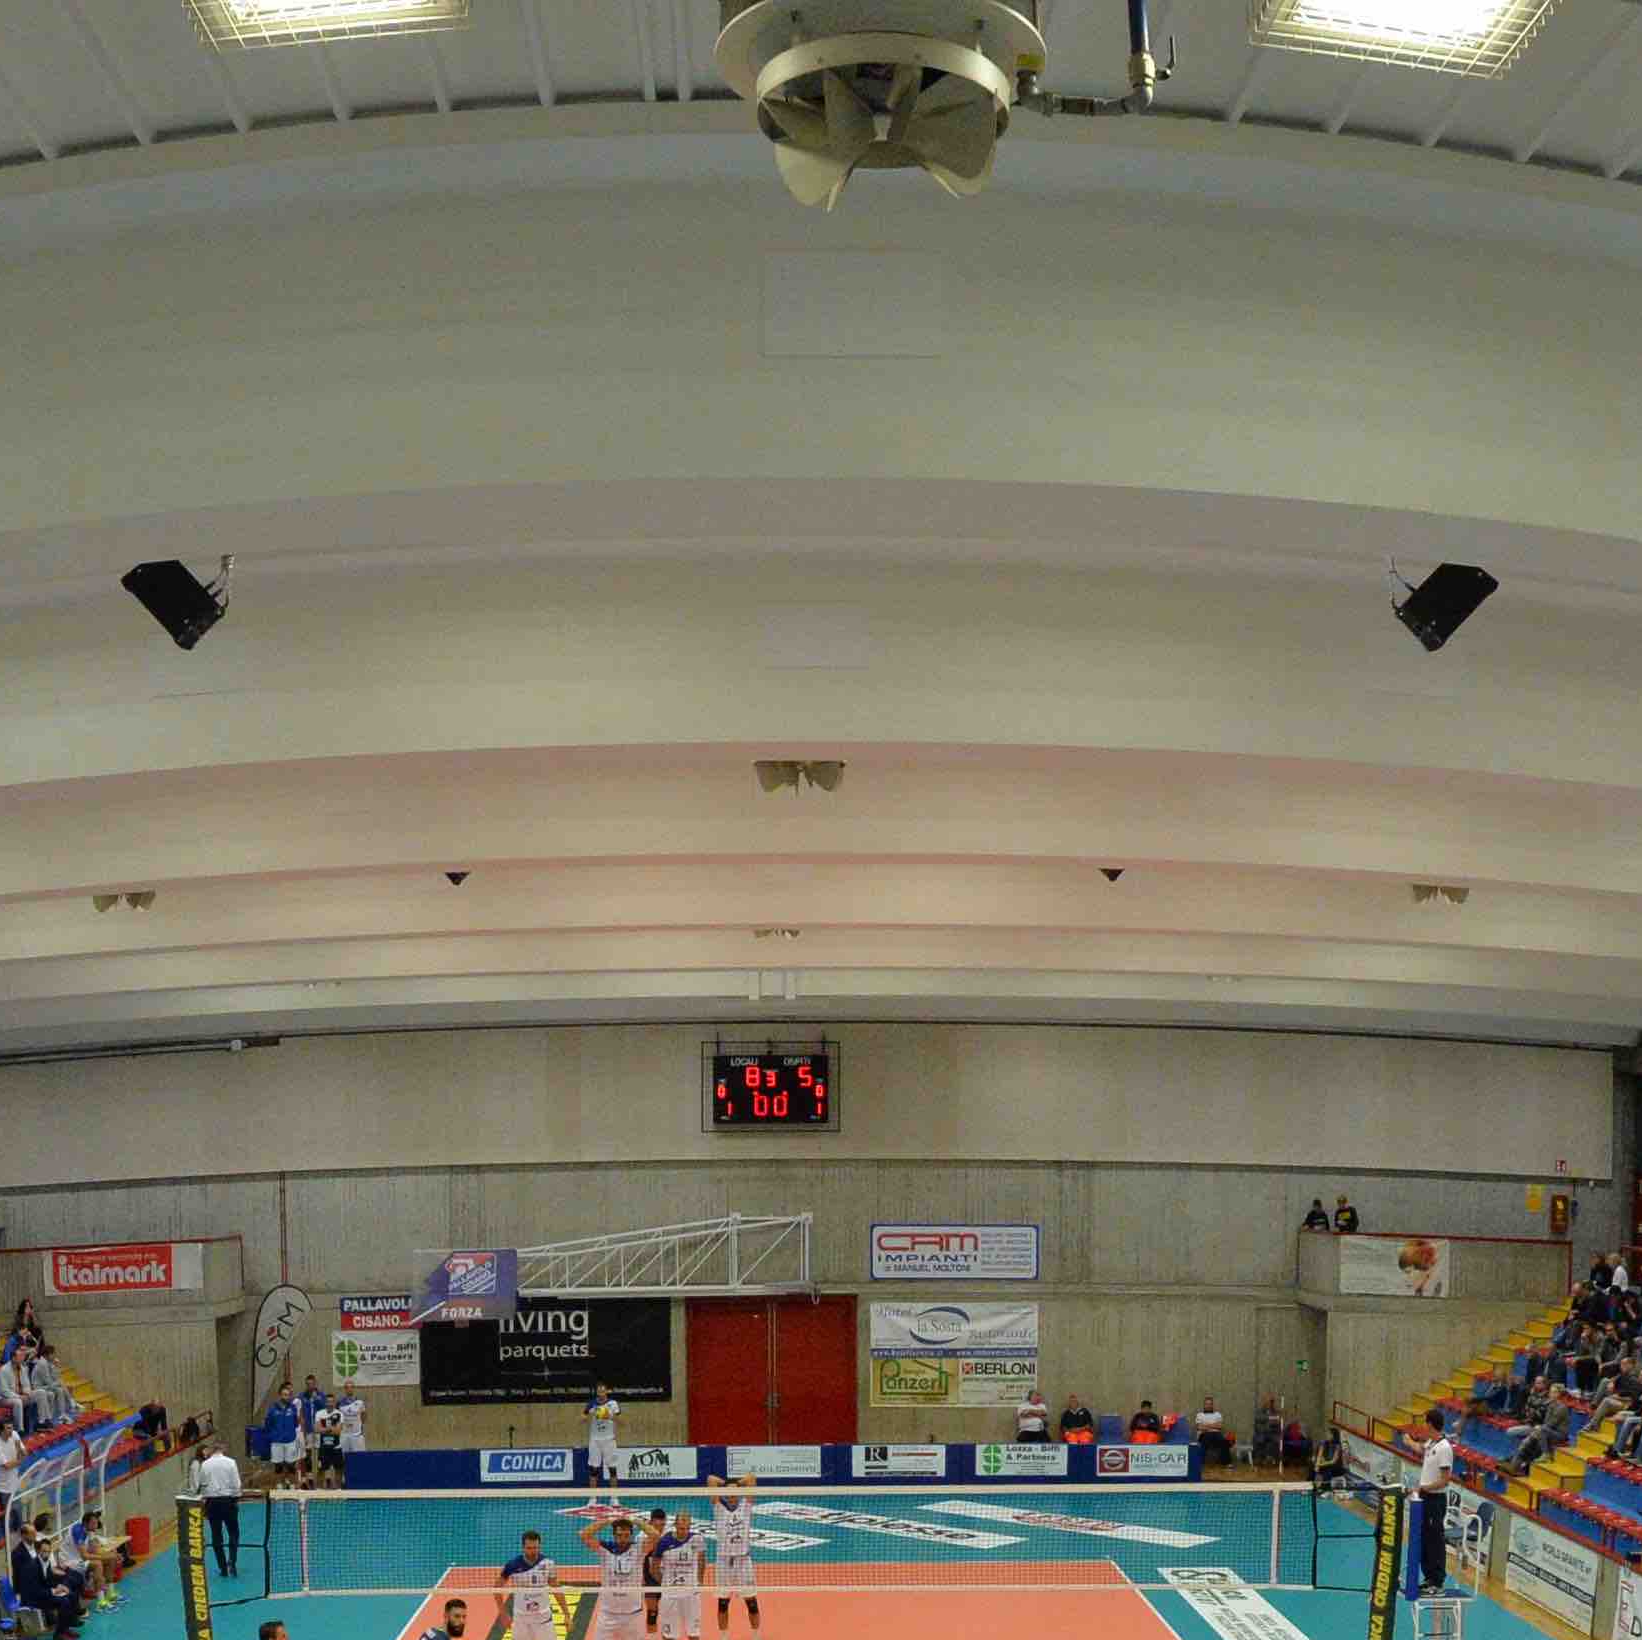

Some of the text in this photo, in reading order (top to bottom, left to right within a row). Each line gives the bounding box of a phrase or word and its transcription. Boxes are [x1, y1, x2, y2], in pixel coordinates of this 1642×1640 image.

[745, 1066, 760, 1087] 8
[877, 1253, 978, 1263] IMPIANTI
[499, 1344, 589, 1361] parquets
[974, 1363, 1036, 1375] BERLONI
[501, 1454, 565, 1471] CONICA
[1382, 1495, 1397, 1546] BANCA
[1373, 1550, 1393, 1608] CREDEM
